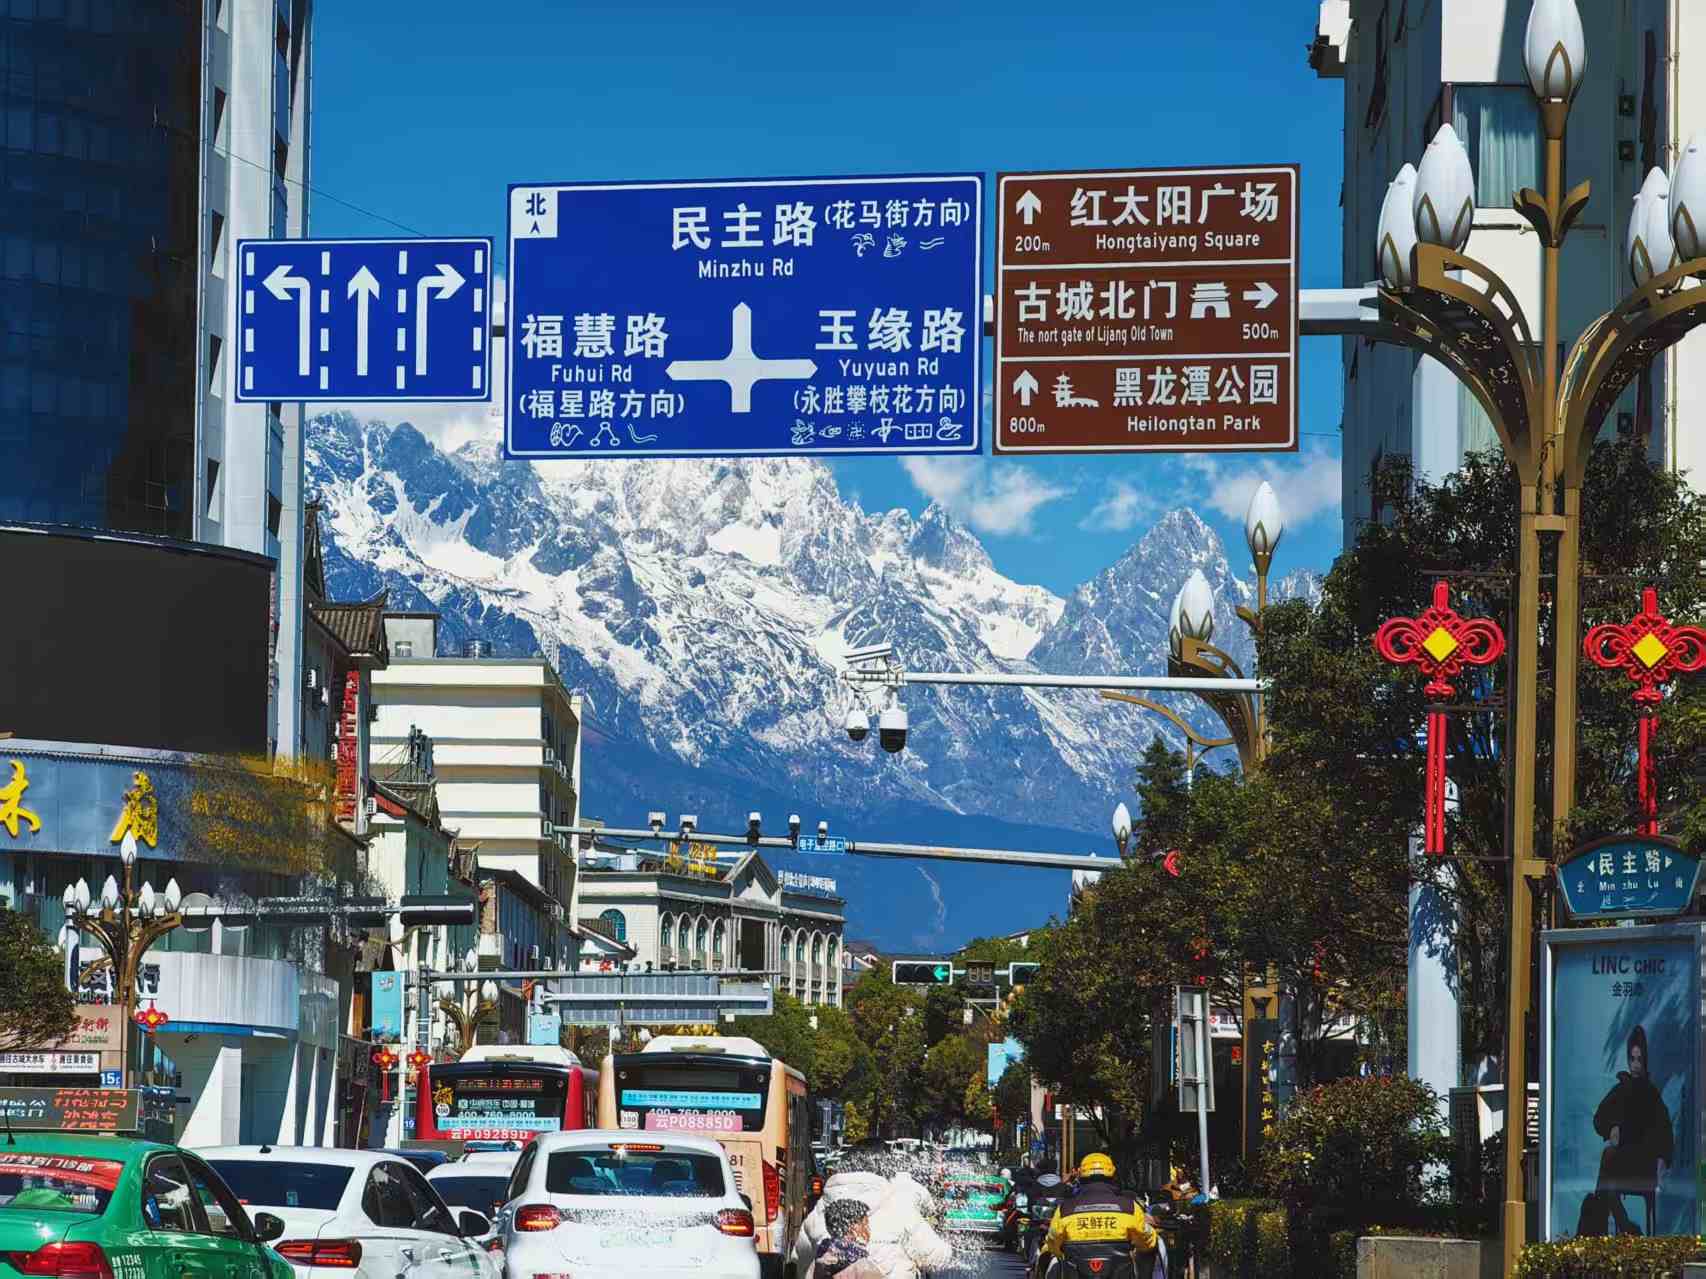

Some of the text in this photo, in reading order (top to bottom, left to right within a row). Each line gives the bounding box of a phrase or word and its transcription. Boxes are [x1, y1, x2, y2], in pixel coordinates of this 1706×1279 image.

[525, 194, 546, 216] 北
[824, 198, 971, 229] (花马街方向)
[1070, 182, 1279, 227] 红太阳广场
[672, 200, 817, 250] 民主路
[1015, 236, 1050, 252] 200m
[1096, 231, 1260, 253] Hongtaiyang Square
[698, 259, 794, 279] Minzhu Rd
[1014, 280, 1177, 322] 古城北门
[521, 313, 669, 359] 福慧路
[815, 307, 966, 353] 玉缘路
[1017, 326, 1173, 346] The nort gate of Lijang Old Town
[1242, 323, 1279, 339] 500m
[551, 365, 632, 382] Fuhui Rd
[839, 358, 938, 379] Yuyuan Rd
[1113, 364, 1278, 407] 黑龙潭公园
[519, 388, 685, 419] (福星路方向)
[793, 384, 966, 416] (永胜攀枝花方向)
[1010, 417, 1045, 433] 800m
[1127, 415, 1261, 435] Heilongtan Park
[1599, 850, 1661, 875] 民主路
[1599, 882, 1616, 892] Min
[1648, 879, 1659, 889] Lu
[1591, 954, 1630, 975] LINC
